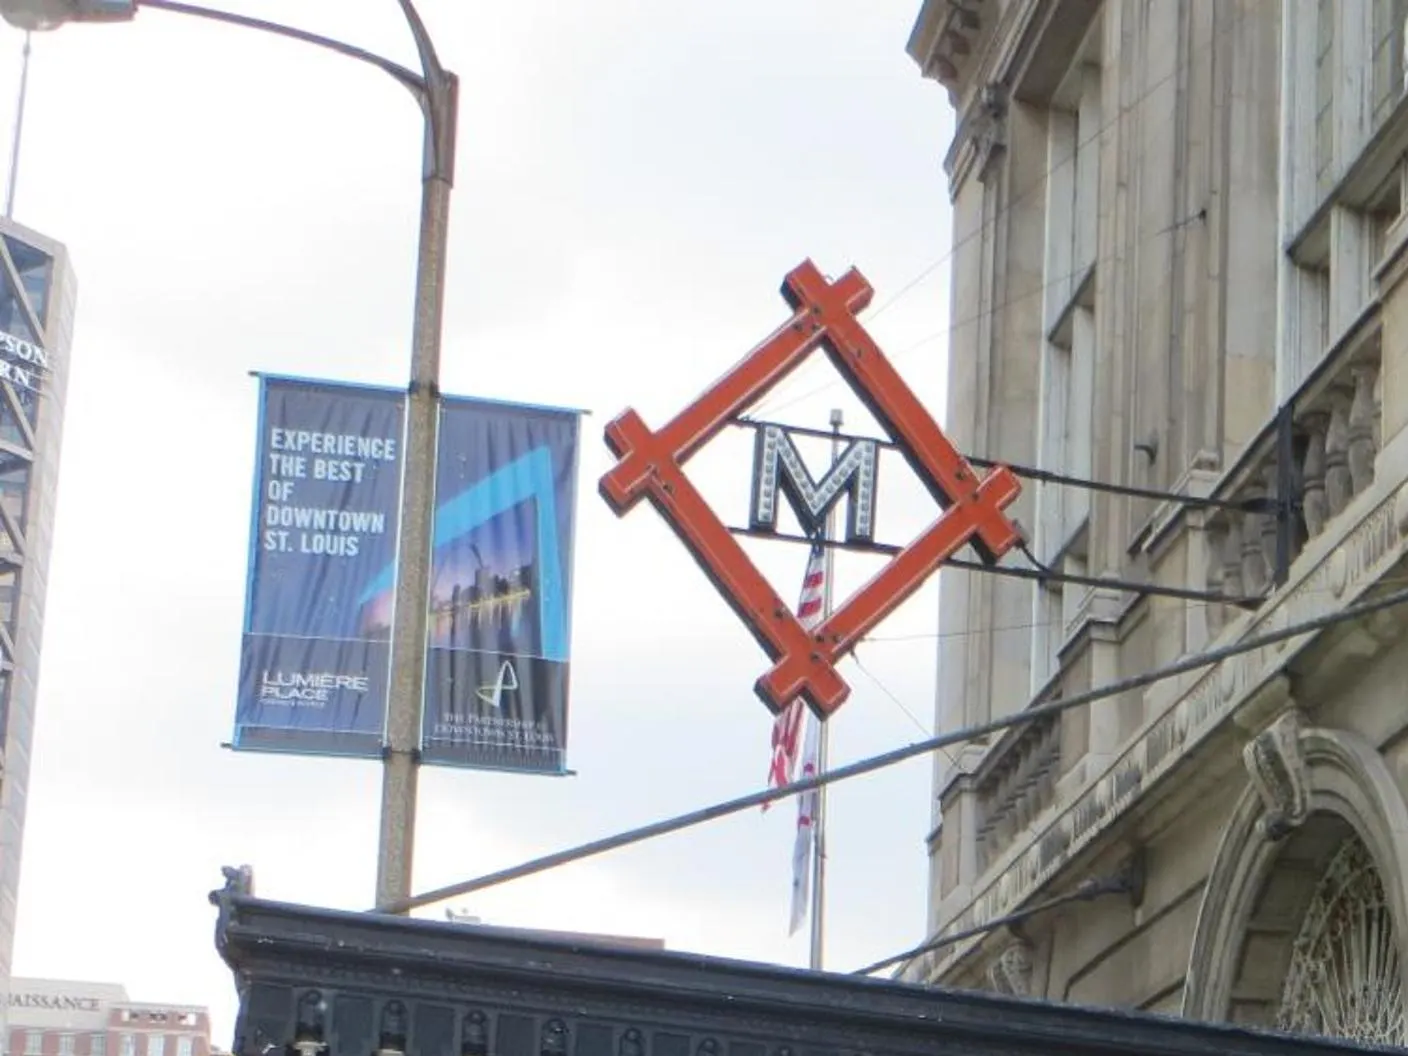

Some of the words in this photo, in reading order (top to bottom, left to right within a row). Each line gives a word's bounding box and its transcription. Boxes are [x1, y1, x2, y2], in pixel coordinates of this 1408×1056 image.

[271, 428, 396, 460] EXPERIENCE
[269, 453, 307, 479] THE
[314, 458, 365, 483] BEST
[749, 420, 880, 543] M
[268, 480, 295, 501] OF
[266, 504, 385, 533] DOWNTOWN
[264, 530, 294, 552] ST.
[301, 533, 360, 556] LOUIS
[261, 685, 329, 701] PLACE
